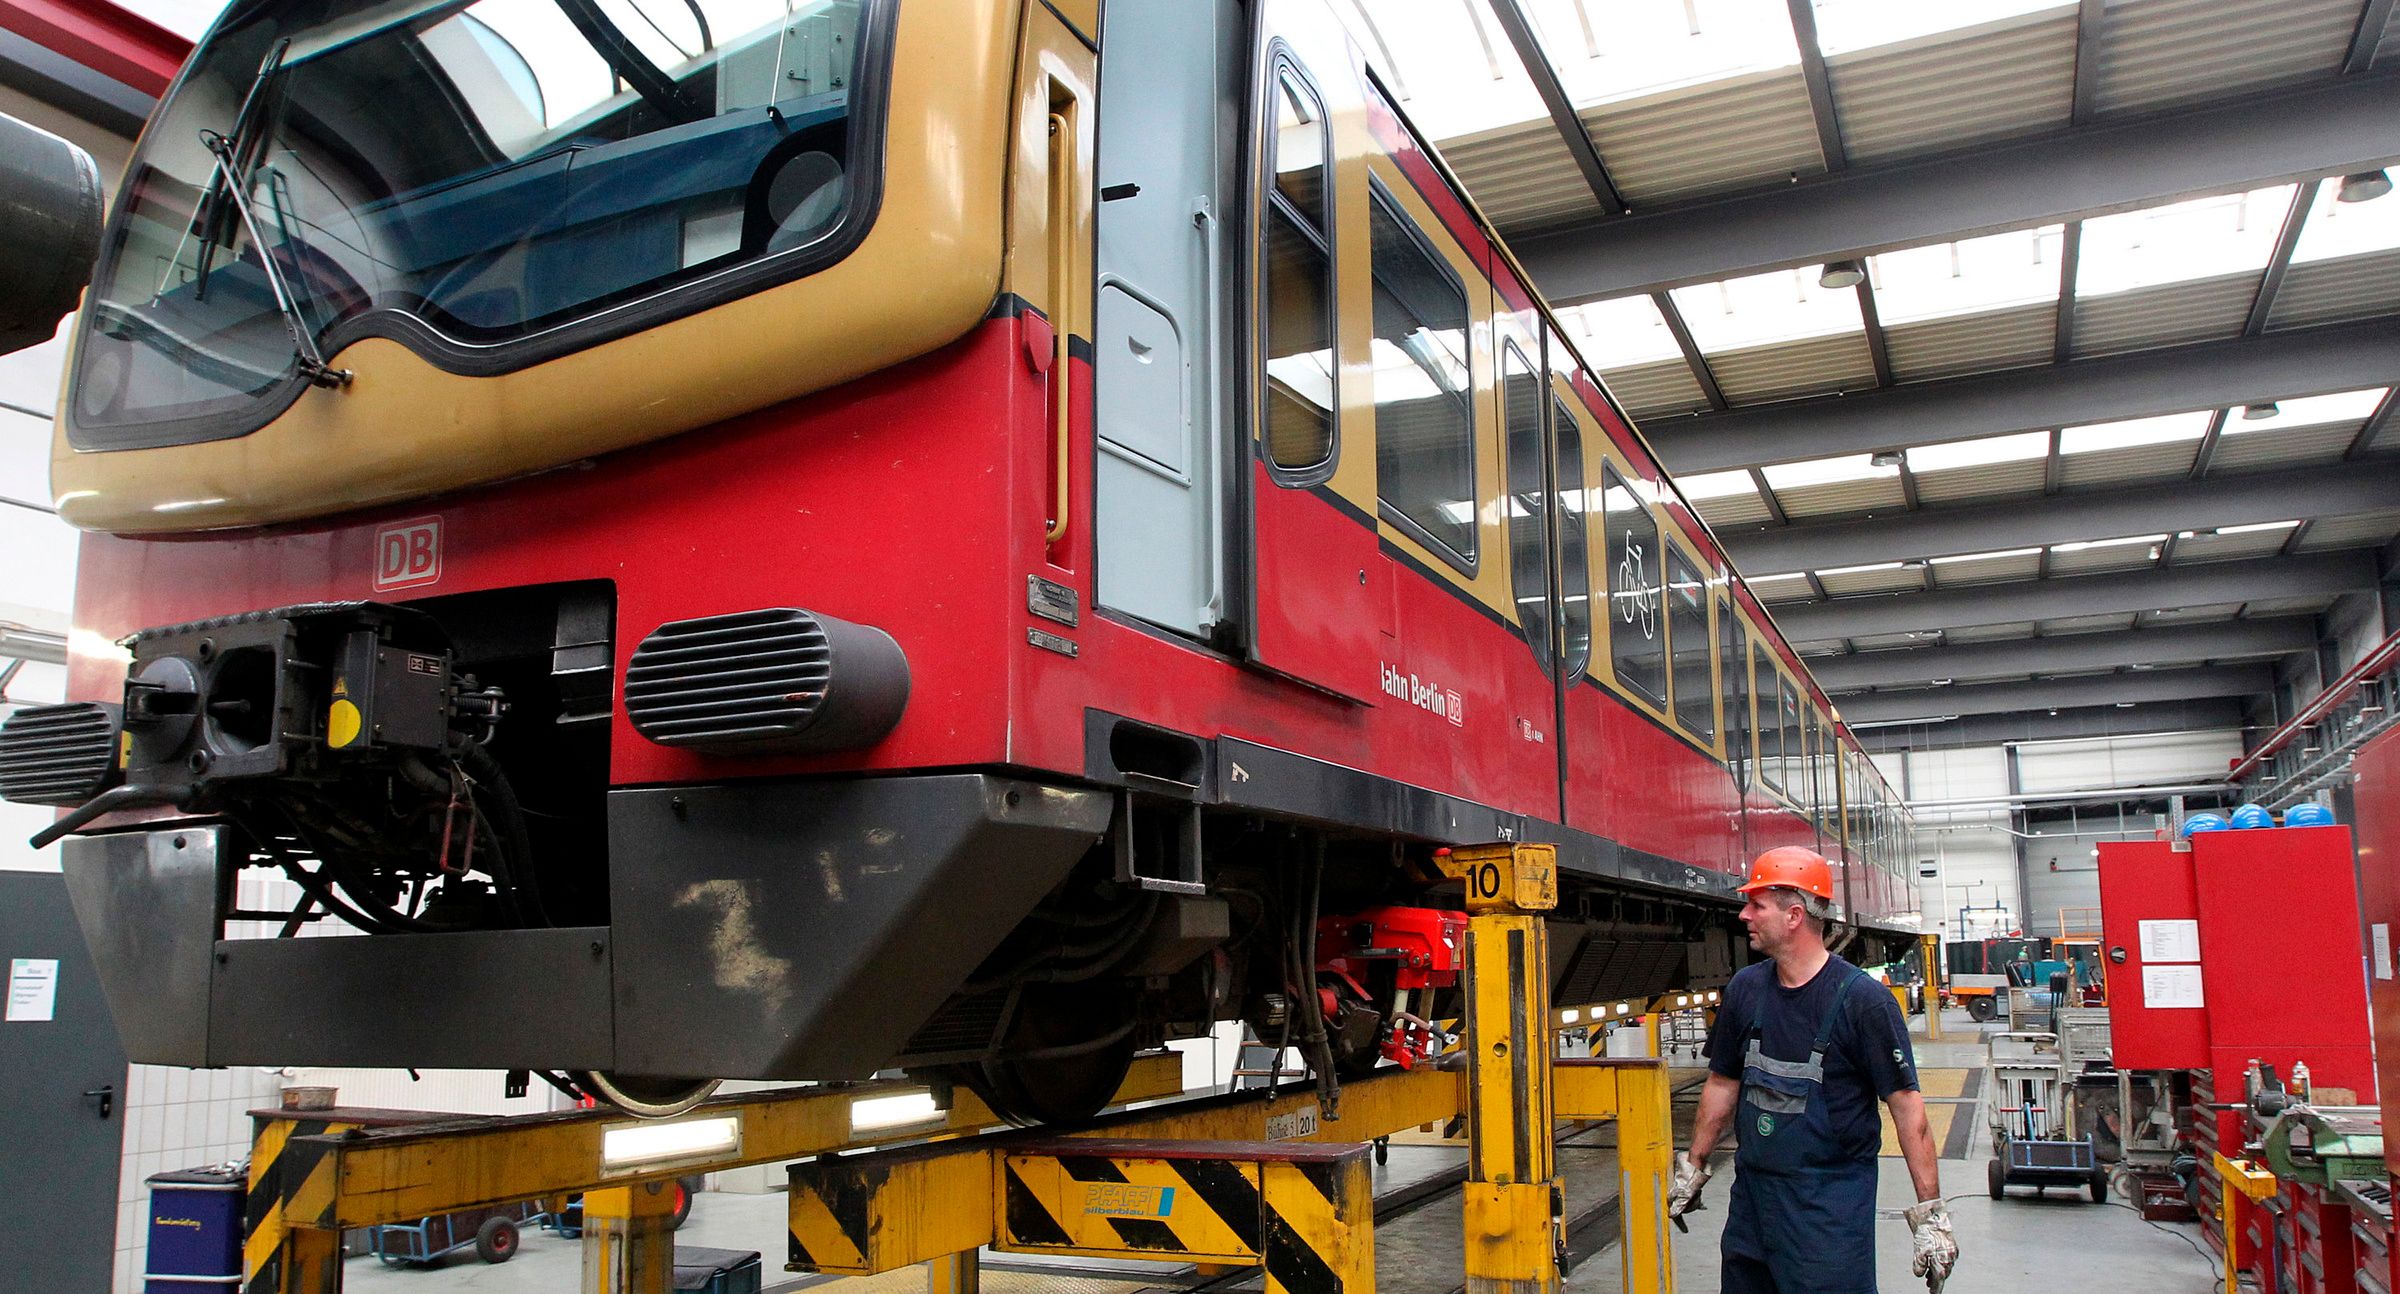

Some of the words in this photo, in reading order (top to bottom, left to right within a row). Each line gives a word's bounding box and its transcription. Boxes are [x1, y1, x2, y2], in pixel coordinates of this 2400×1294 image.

[379, 524, 438, 583] DB
[1410, 673, 1446, 717] Berlin
[1447, 692, 1462, 724] DB
[1466, 862, 1500, 898] 10
[1300, 1116, 1310, 1135] 20
[1759, 1115, 1772, 1133] S
[1085, 1184, 1149, 1207] PFAFF
[1084, 1207, 1144, 1216] silberblau
